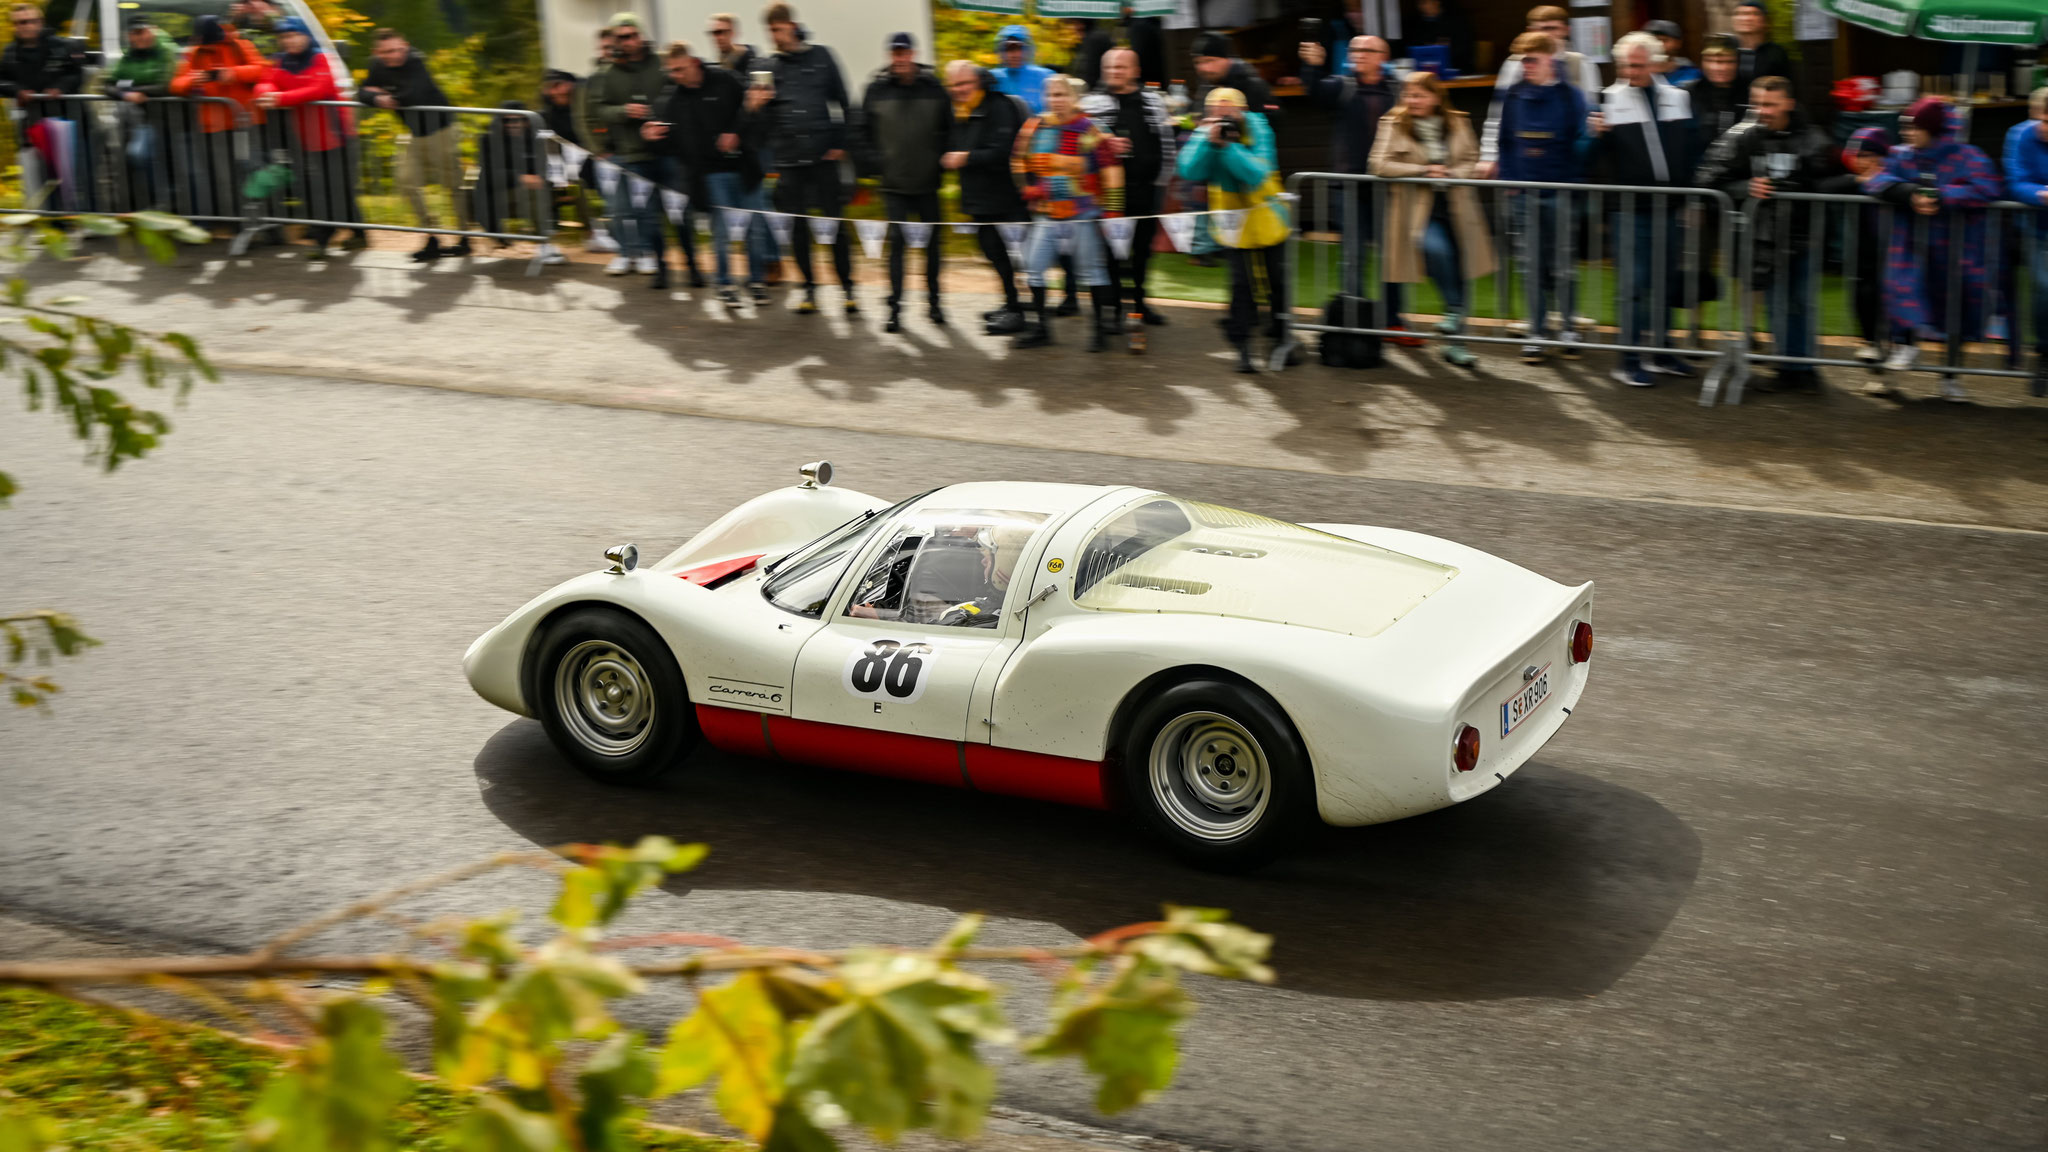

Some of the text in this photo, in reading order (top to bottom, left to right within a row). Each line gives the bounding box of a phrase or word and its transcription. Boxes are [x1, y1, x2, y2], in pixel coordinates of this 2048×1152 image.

[851, 639, 934, 698] 86
[709, 684, 783, 703] Carrera 6
[873, 701, 882, 714] E
